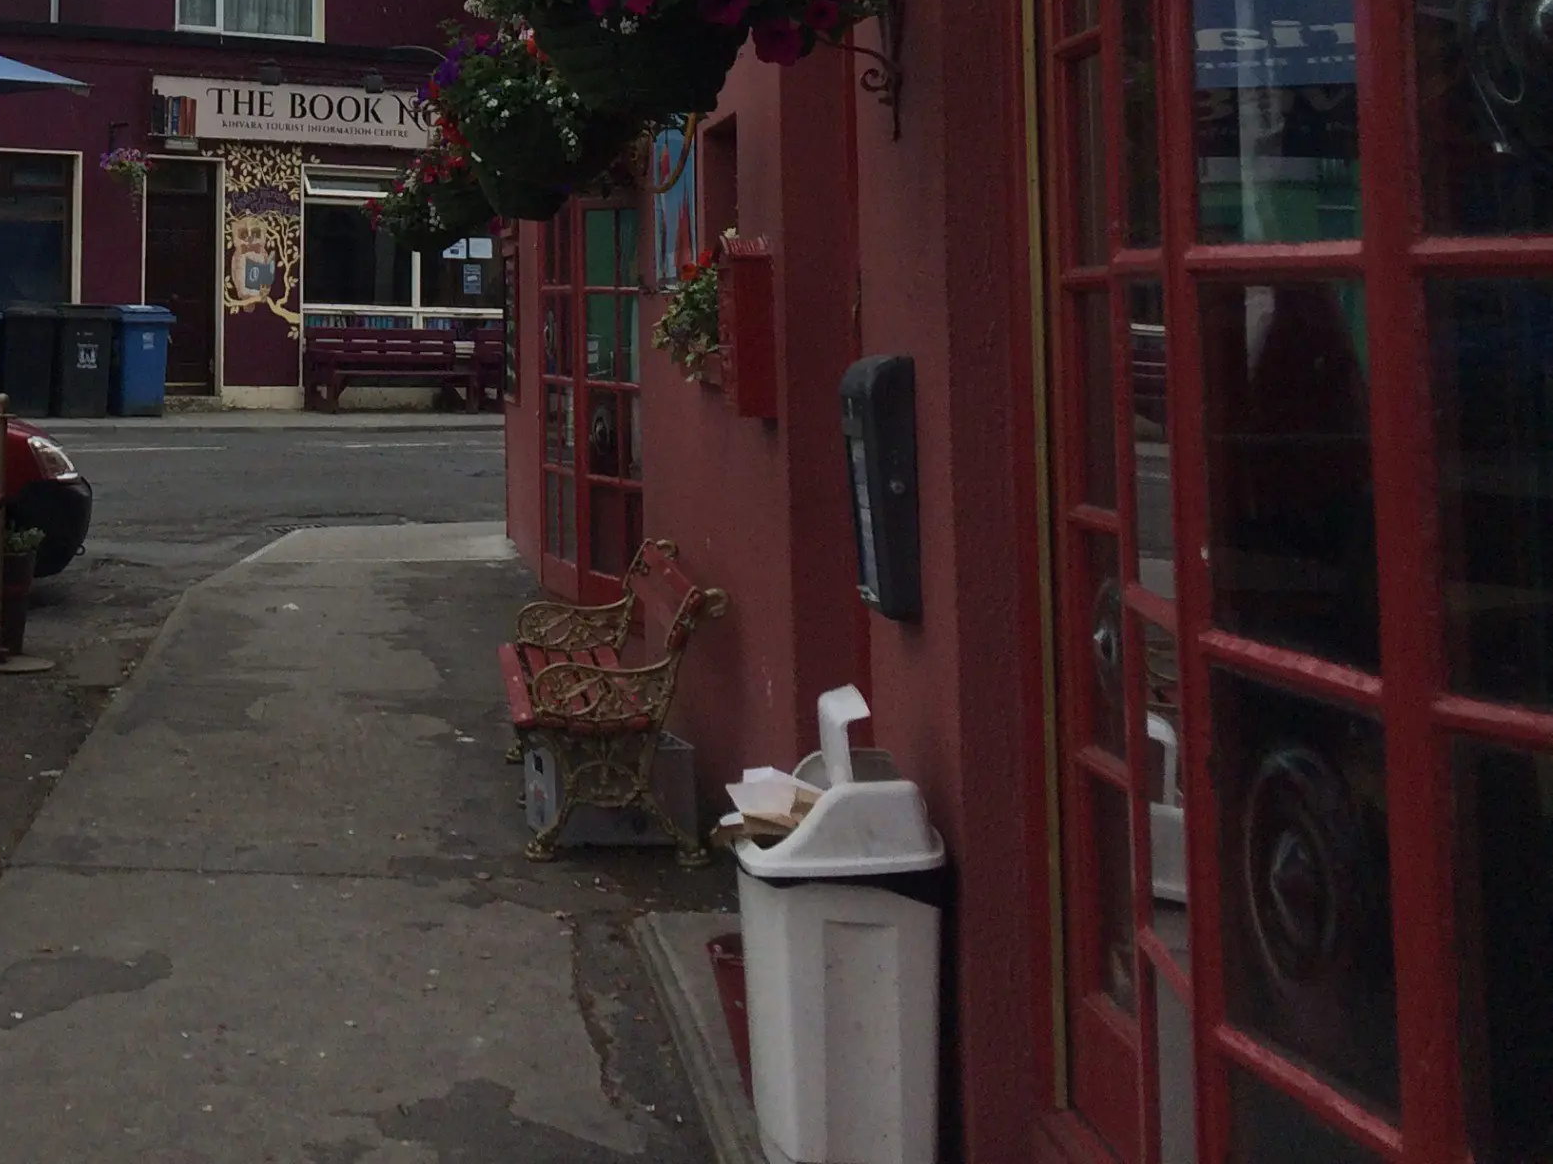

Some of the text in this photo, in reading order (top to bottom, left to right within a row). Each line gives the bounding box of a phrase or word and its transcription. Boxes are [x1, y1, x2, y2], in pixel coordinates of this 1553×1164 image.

[205, 87, 276, 118] THE
[289, 91, 383, 124] BOOK
[221, 119, 410, 139] KINVARA TOURIST INFORMATION CENTRE
